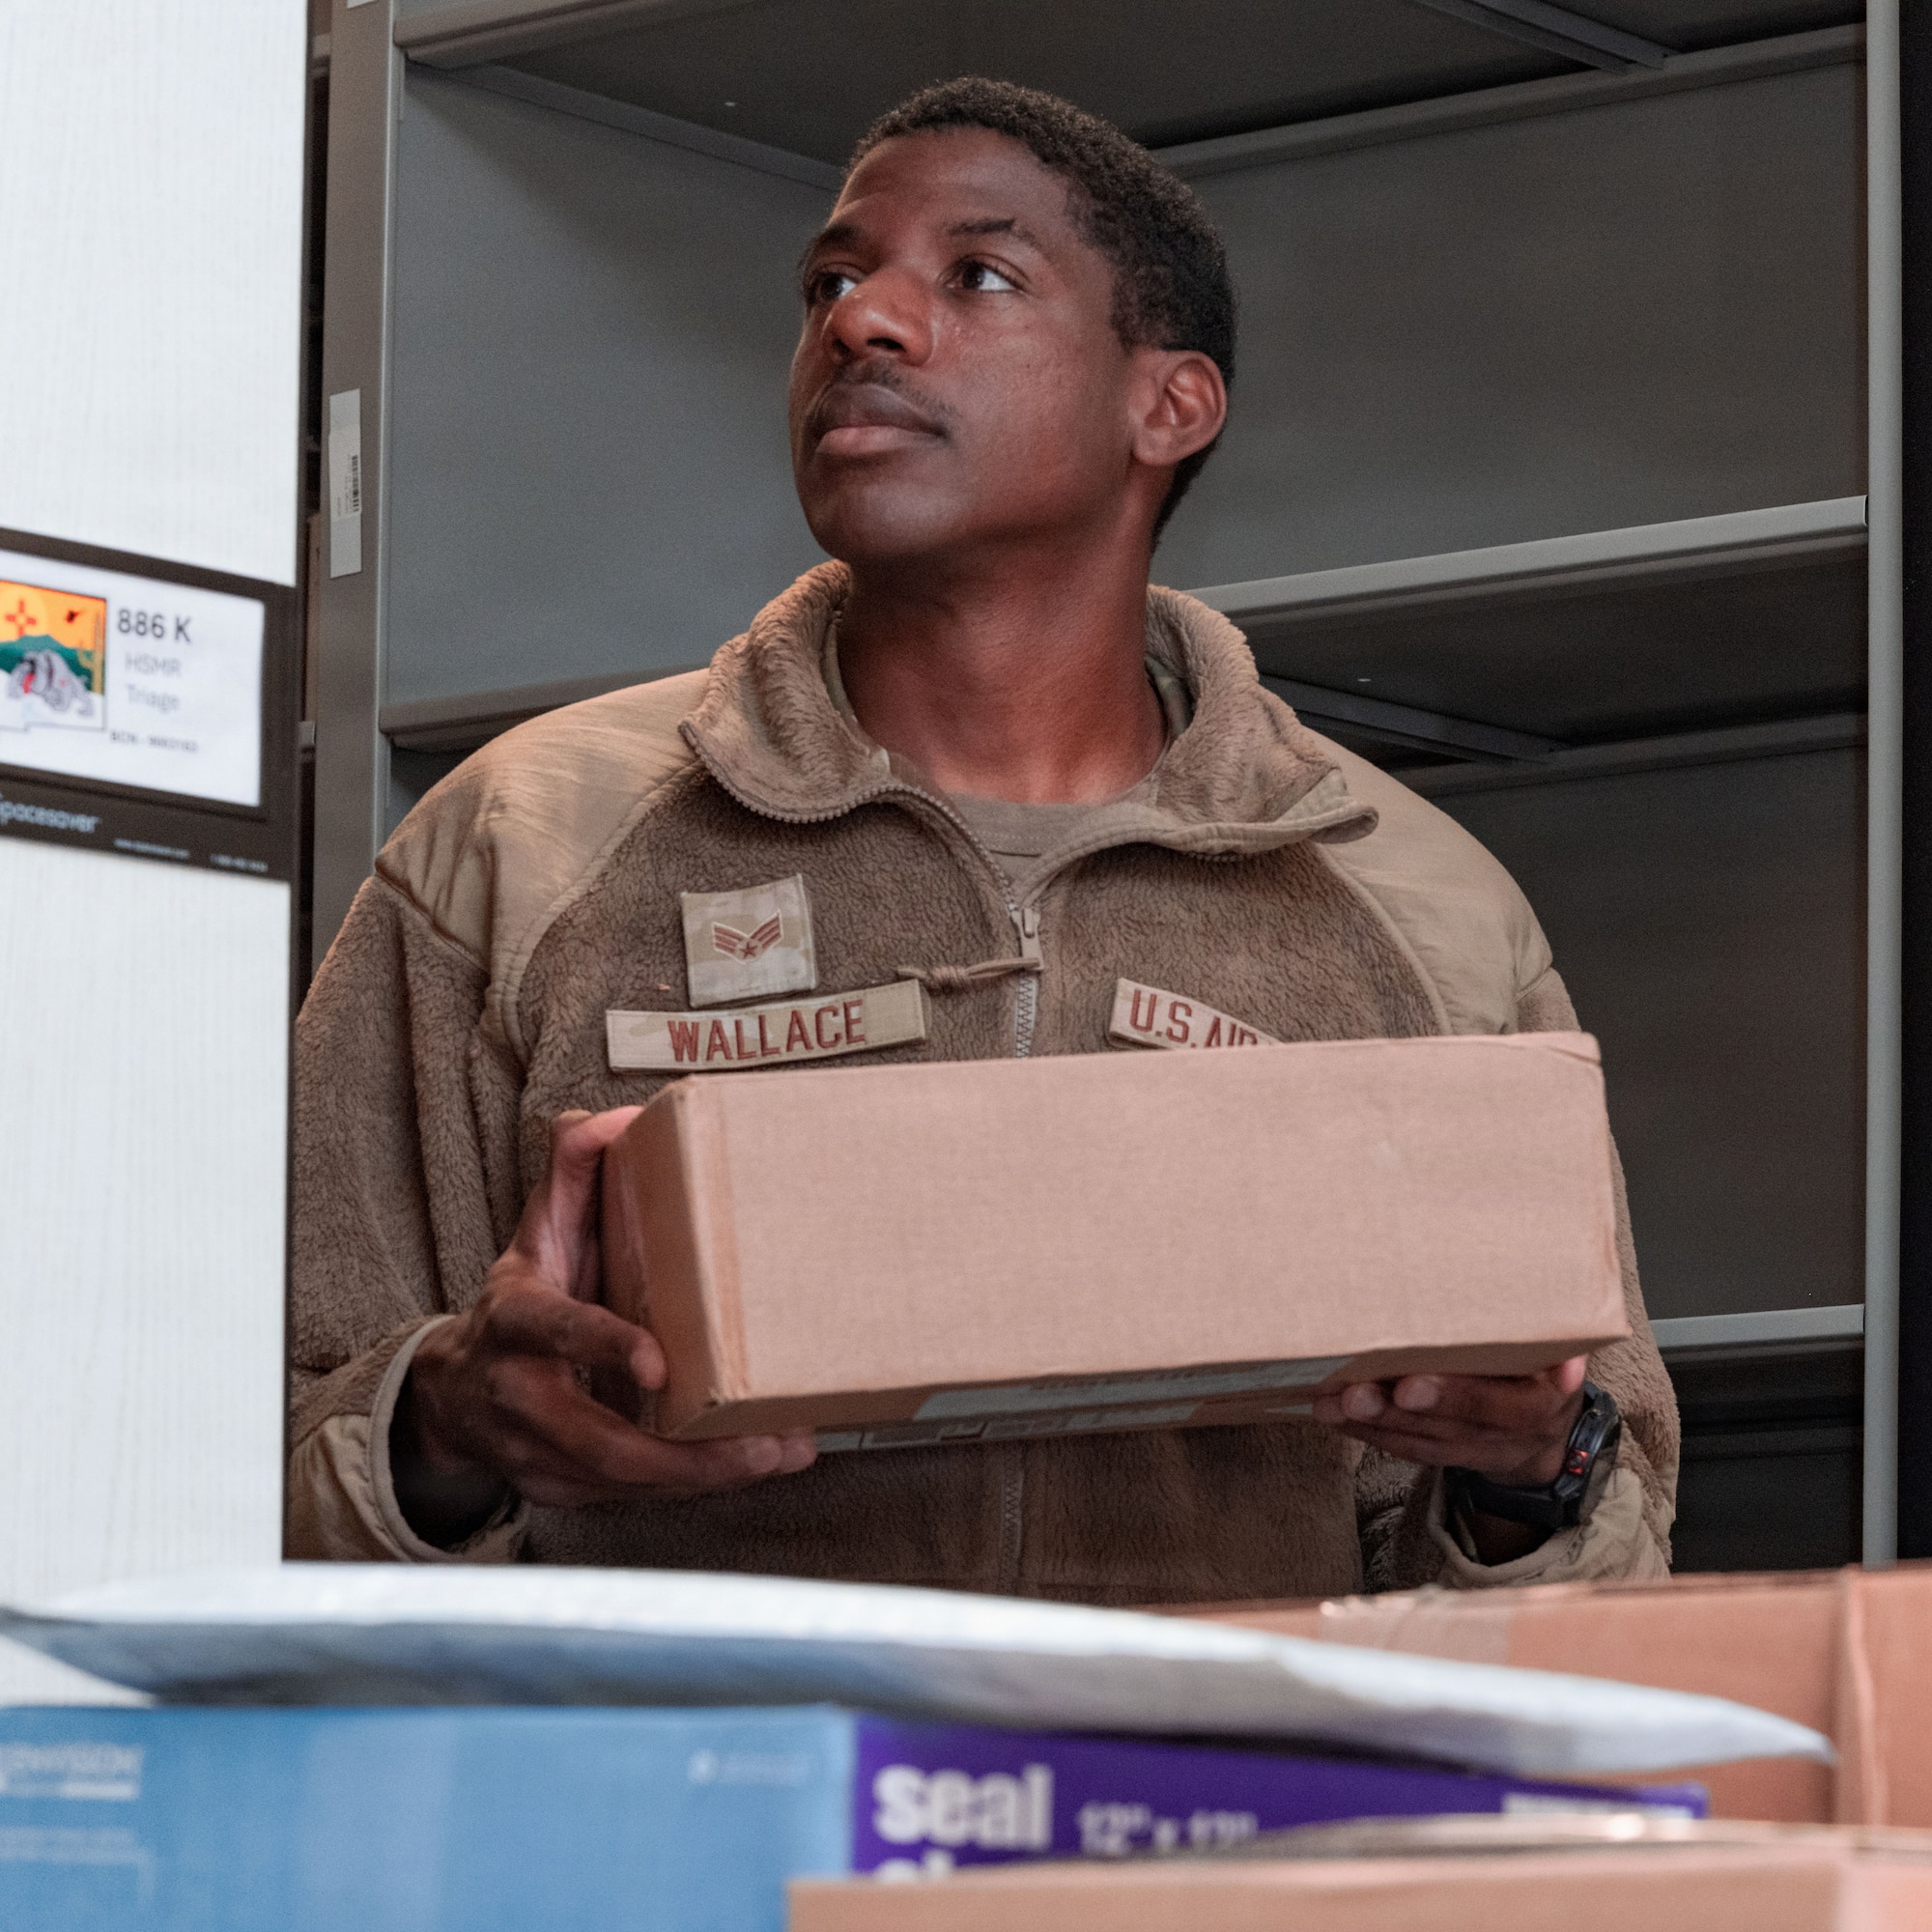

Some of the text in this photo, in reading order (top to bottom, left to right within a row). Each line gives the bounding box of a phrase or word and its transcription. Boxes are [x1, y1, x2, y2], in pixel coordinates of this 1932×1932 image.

[117, 608, 192, 643] 886 K
[126, 683, 181, 714] Triage
[668, 999, 867, 1063] WALLACE
[1129, 988, 1197, 1049] U.S.
[873, 1762, 1054, 1853] seal
